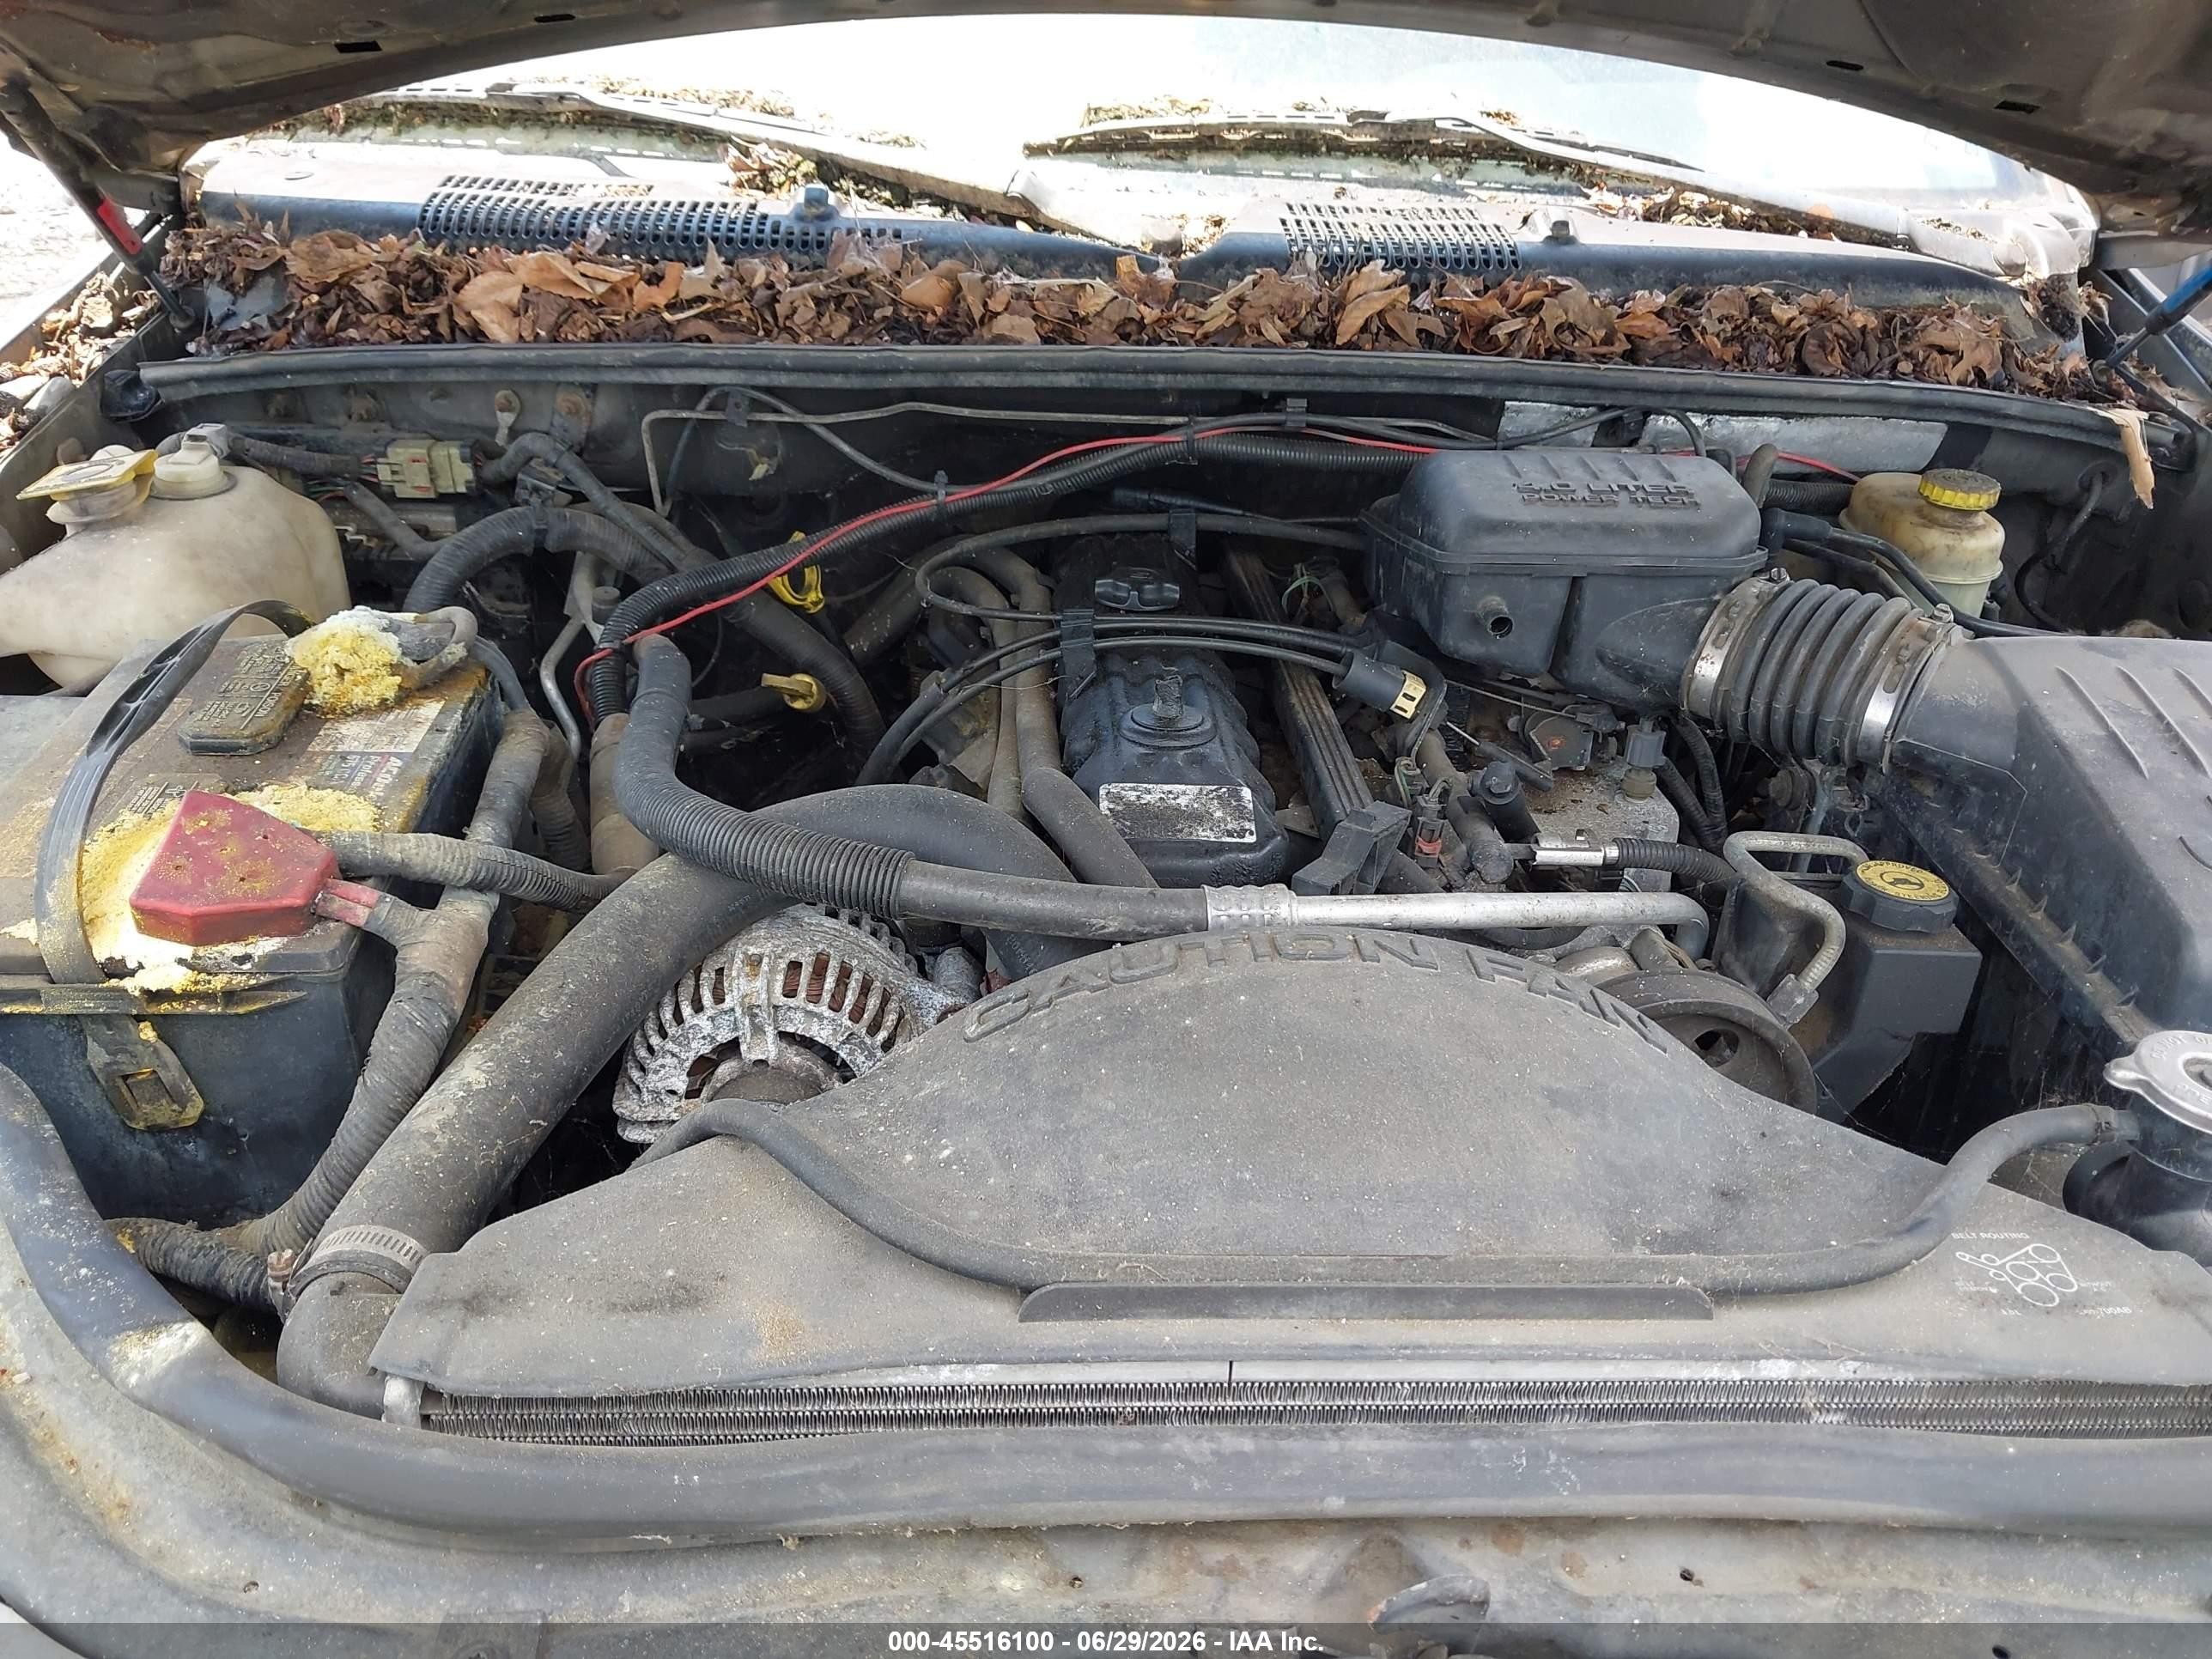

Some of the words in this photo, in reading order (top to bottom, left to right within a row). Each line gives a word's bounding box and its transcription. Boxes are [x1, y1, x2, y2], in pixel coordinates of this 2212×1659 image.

[1588, 482, 1696, 496] LITER
[1522, 494, 1620, 507] POWER
[1629, 495, 1702, 509] TECH
[254, 692, 283, 717] POISON
[963, 932, 1440, 1042] CAUTION
[1465, 947, 1670, 1057] FAN
